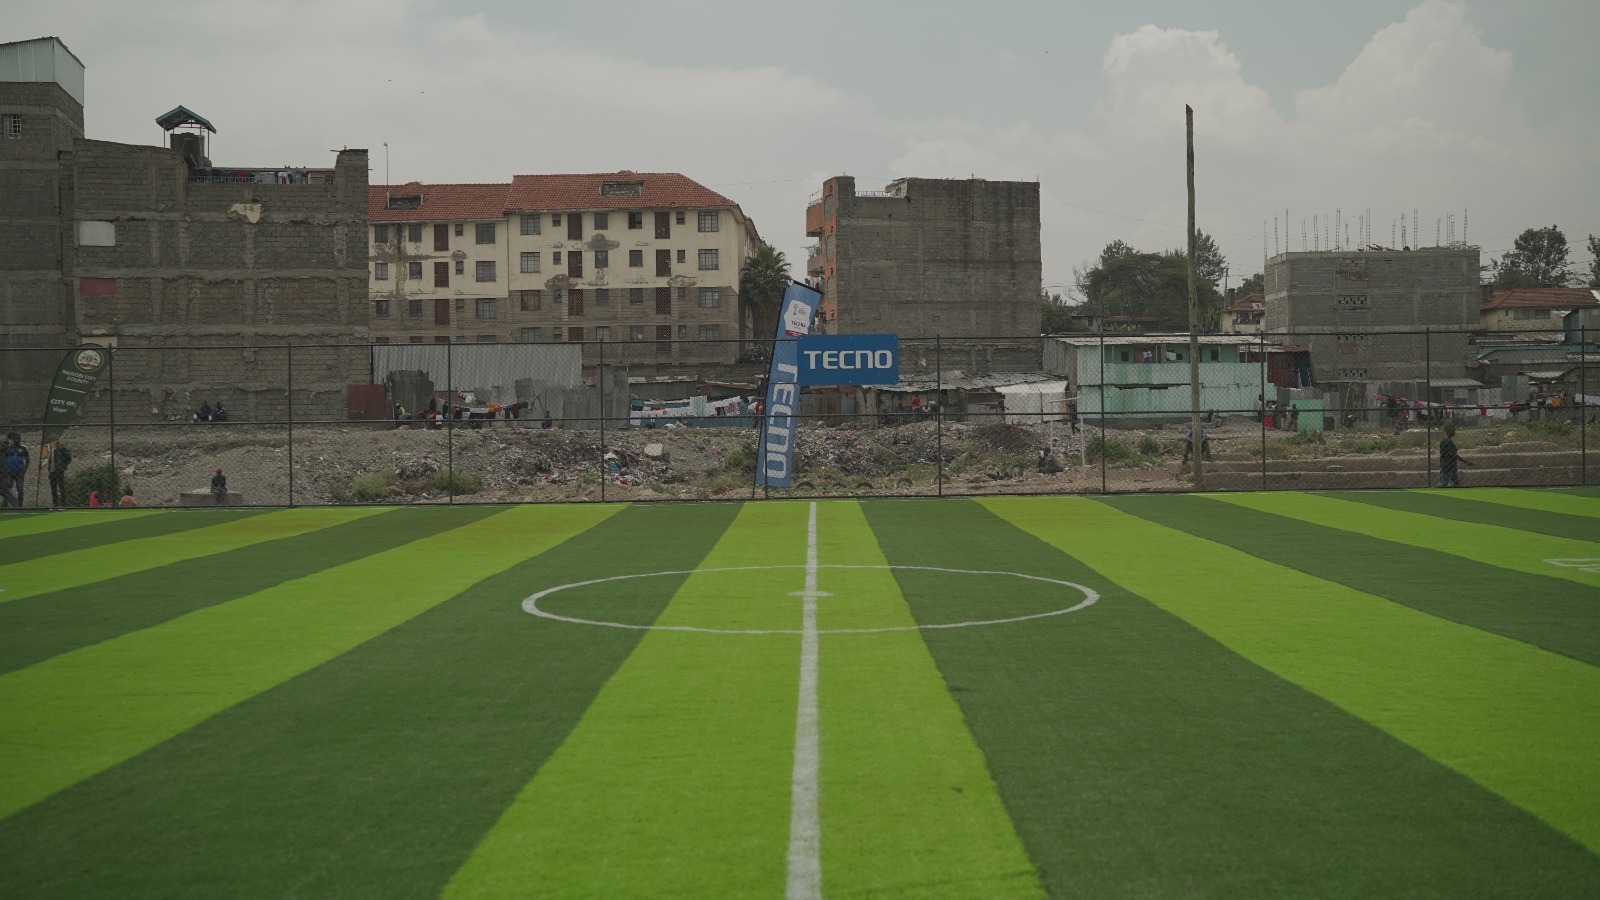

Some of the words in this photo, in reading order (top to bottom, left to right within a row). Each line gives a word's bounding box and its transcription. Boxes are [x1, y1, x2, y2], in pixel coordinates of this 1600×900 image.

[803, 350, 893, 370] TECNO
[67, 376, 89, 384] COUNTY
[763, 363, 798, 479] TECNO
